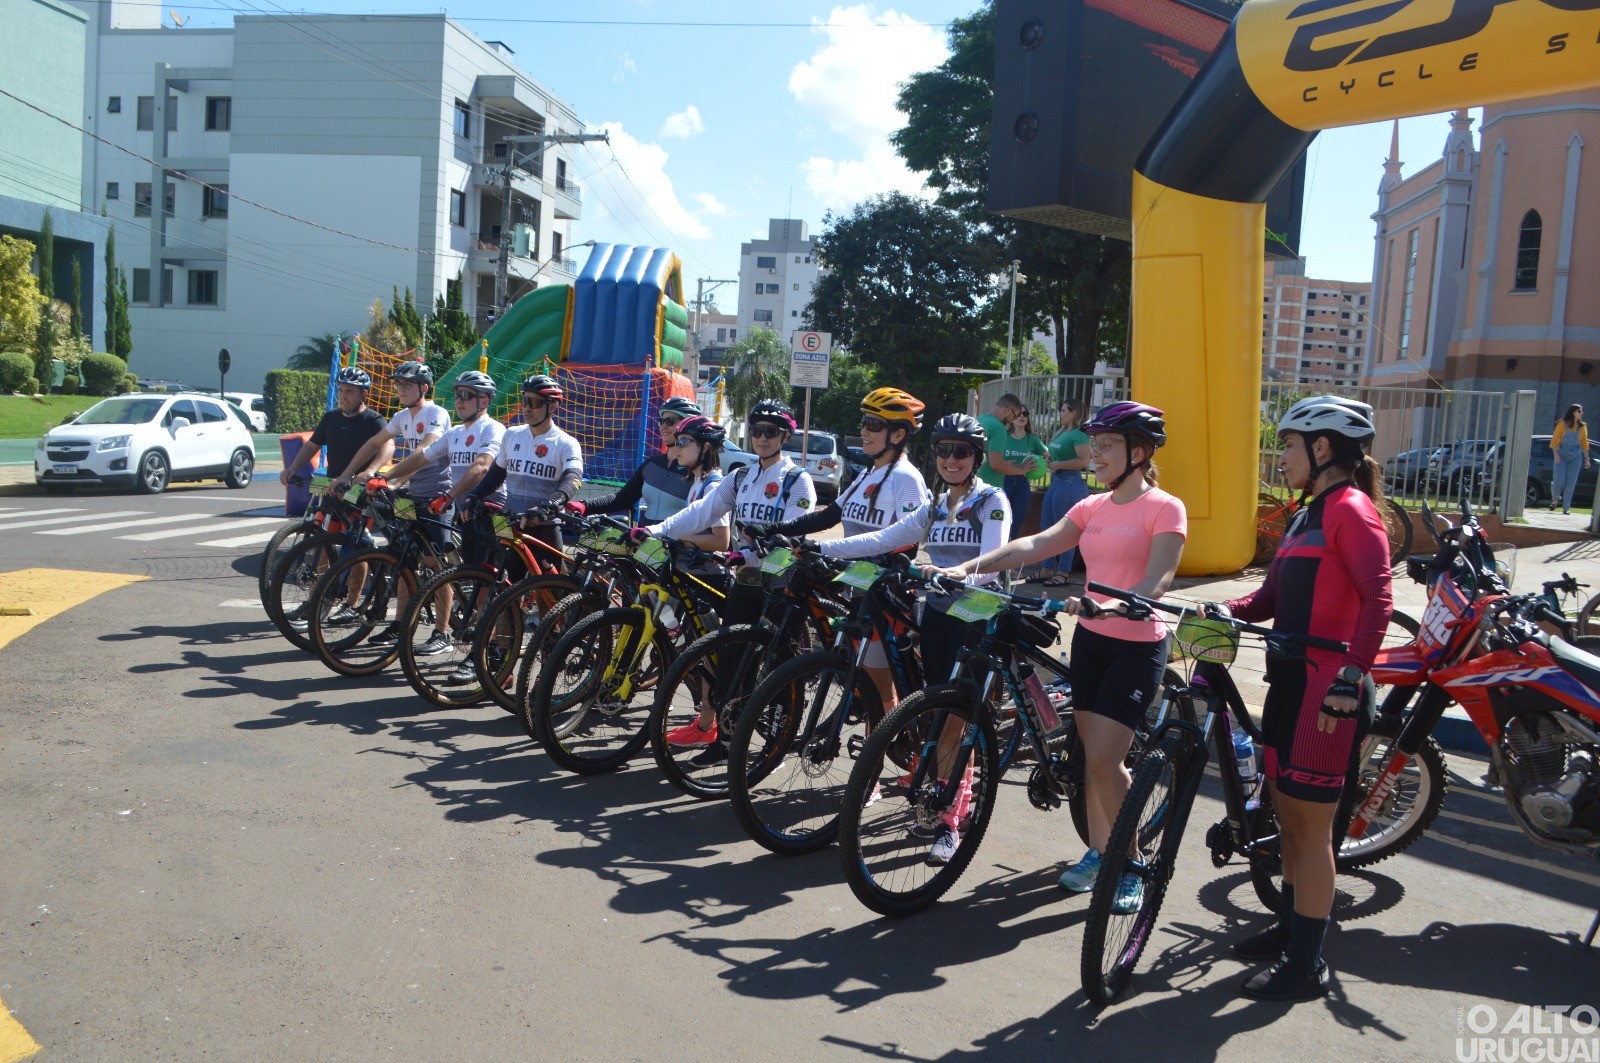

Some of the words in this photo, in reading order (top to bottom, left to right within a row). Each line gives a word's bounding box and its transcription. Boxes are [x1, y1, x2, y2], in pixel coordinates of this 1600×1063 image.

[1302, 52, 1479, 102] CYCLE
[807, 337, 816, 347] E
[523, 460, 557, 478] TEAM
[941, 526, 982, 543] TEAM
[1420, 627, 1435, 647] DANI
[1443, 665, 1564, 687] CRF
[1359, 770, 1400, 823] MOTUL
